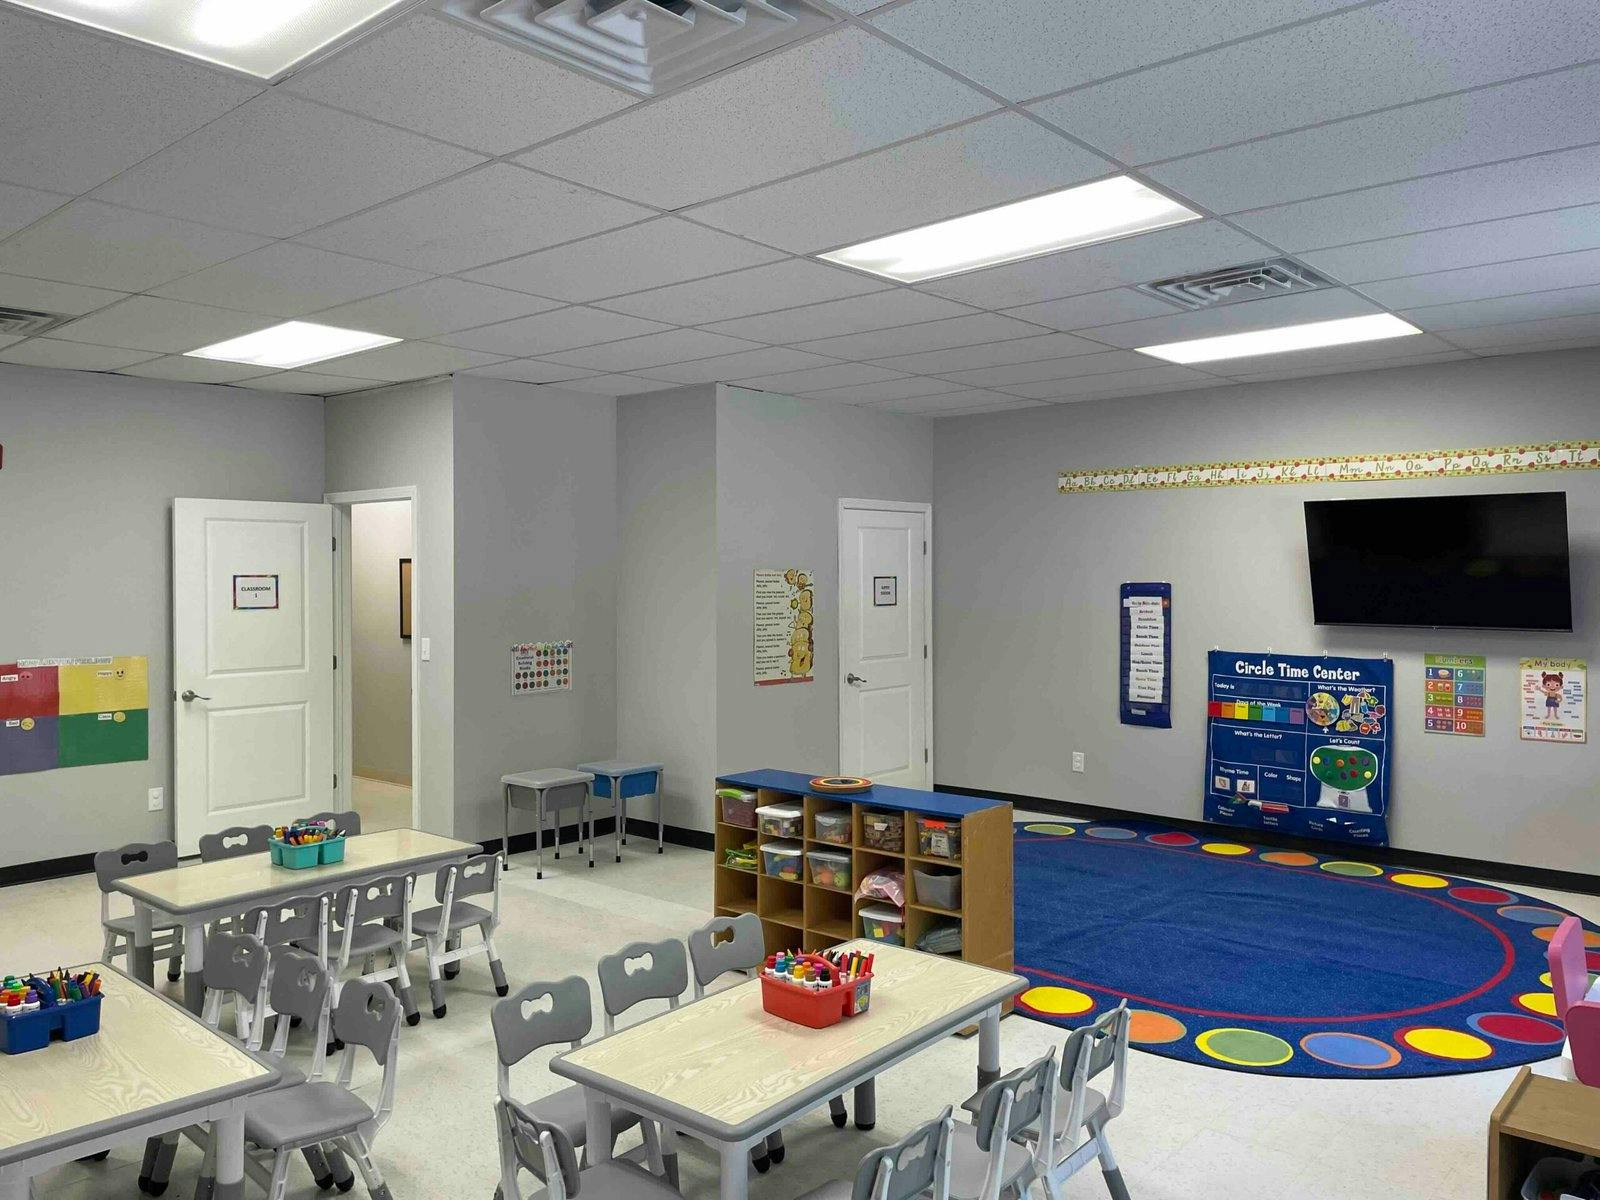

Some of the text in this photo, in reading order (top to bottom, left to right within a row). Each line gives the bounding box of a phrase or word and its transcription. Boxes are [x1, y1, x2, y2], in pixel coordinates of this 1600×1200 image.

[1065, 478, 1077, 486] Aa
[1084, 476, 1096, 485] Bb
[1146, 473, 1158, 483] Ee
[1210, 470, 1224, 480] Hh
[1236, 469, 1246, 479] Ii
[1307, 465, 1320, 476] Ll
[1339, 464, 1363, 474] Mm
[1375, 462, 1395, 472] Nn
[1405, 460, 1424, 471] Oo
[1443, 458, 1461, 471] Pp
[1472, 456, 1490, 469] Qq
[1503, 454, 1522, 466] Rr
[1536, 452, 1551, 464] Ss
[1568, 450, 1584, 462] Tt
[1435, 655, 1473, 665] Numbers
[1534, 660, 1571, 669] My body
[1235, 660, 1361, 681] Circle Time Center
[1428, 668, 1433, 676] 1
[1457, 669, 1463, 678] 6
[1214, 682, 1229, 690] Today
[1317, 684, 1337, 692] What's
[1427, 681, 1434, 689] 2
[1457, 683, 1463, 691] 7
[1427, 693, 1434, 701] 3
[1457, 695, 1463, 703] 8
[1427, 706, 1434, 715] 4
[1457, 708, 1463, 717] 9
[1456, 721, 1467, 730] 10
[1234, 730, 1253, 738] What's
[1264, 732, 1282, 740] Letter?
[1329, 737, 1360, 746] Let's Count
[1236, 768, 1249, 776] Time
[1264, 771, 1278, 779] Color
[1286, 774, 1301, 783] Shape
